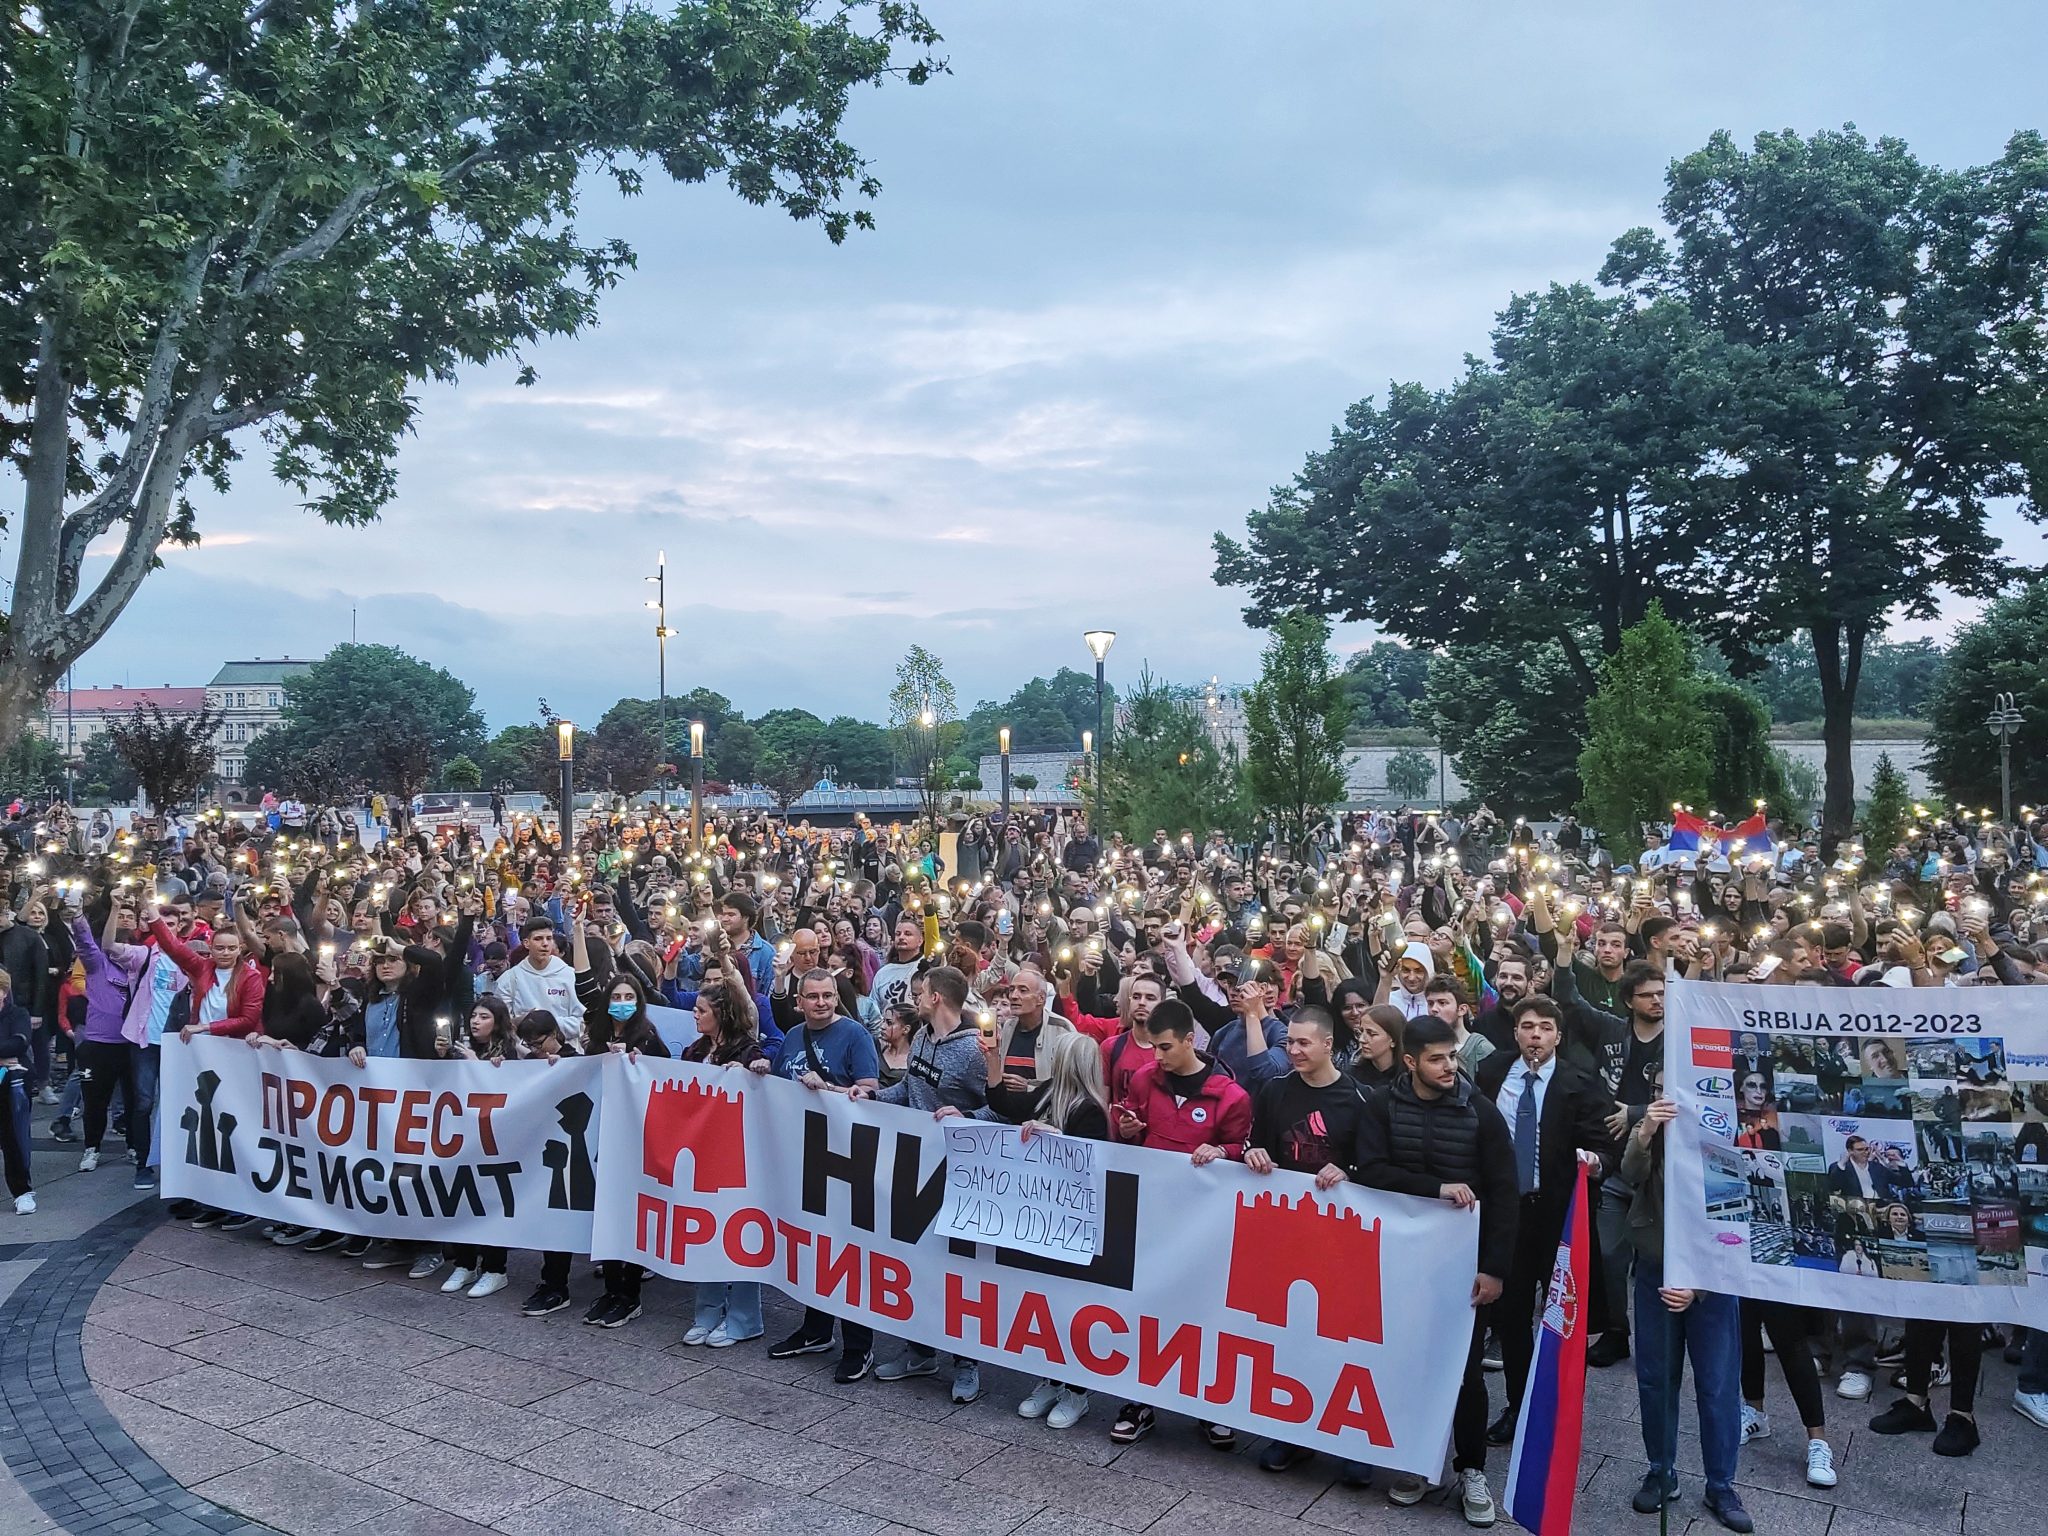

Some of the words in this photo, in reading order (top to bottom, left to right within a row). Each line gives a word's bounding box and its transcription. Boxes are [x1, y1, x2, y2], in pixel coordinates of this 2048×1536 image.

[1743, 1009, 1832, 1031] SRBIJA
[1838, 1013, 1982, 1033] 2012-2023
[262, 1071, 508, 1157] ПРОТЕСТ
[251, 1136, 313, 1200] ЈЕ
[317, 1150, 522, 1218] ИСПИТ
[952, 1128, 1016, 1160] SVE
[1024, 1132, 1093, 1176] ZNAMO!
[954, 1164, 1011, 1196] SAMO
[1018, 1173, 1051, 1203] NAM
[950, 1195, 1004, 1237] KAD
[1014, 1205, 1097, 1254] ODLAZE!
[636, 1193, 914, 1321] ПРОТИВ
[945, 1273, 1394, 1448] НАСИЉА
